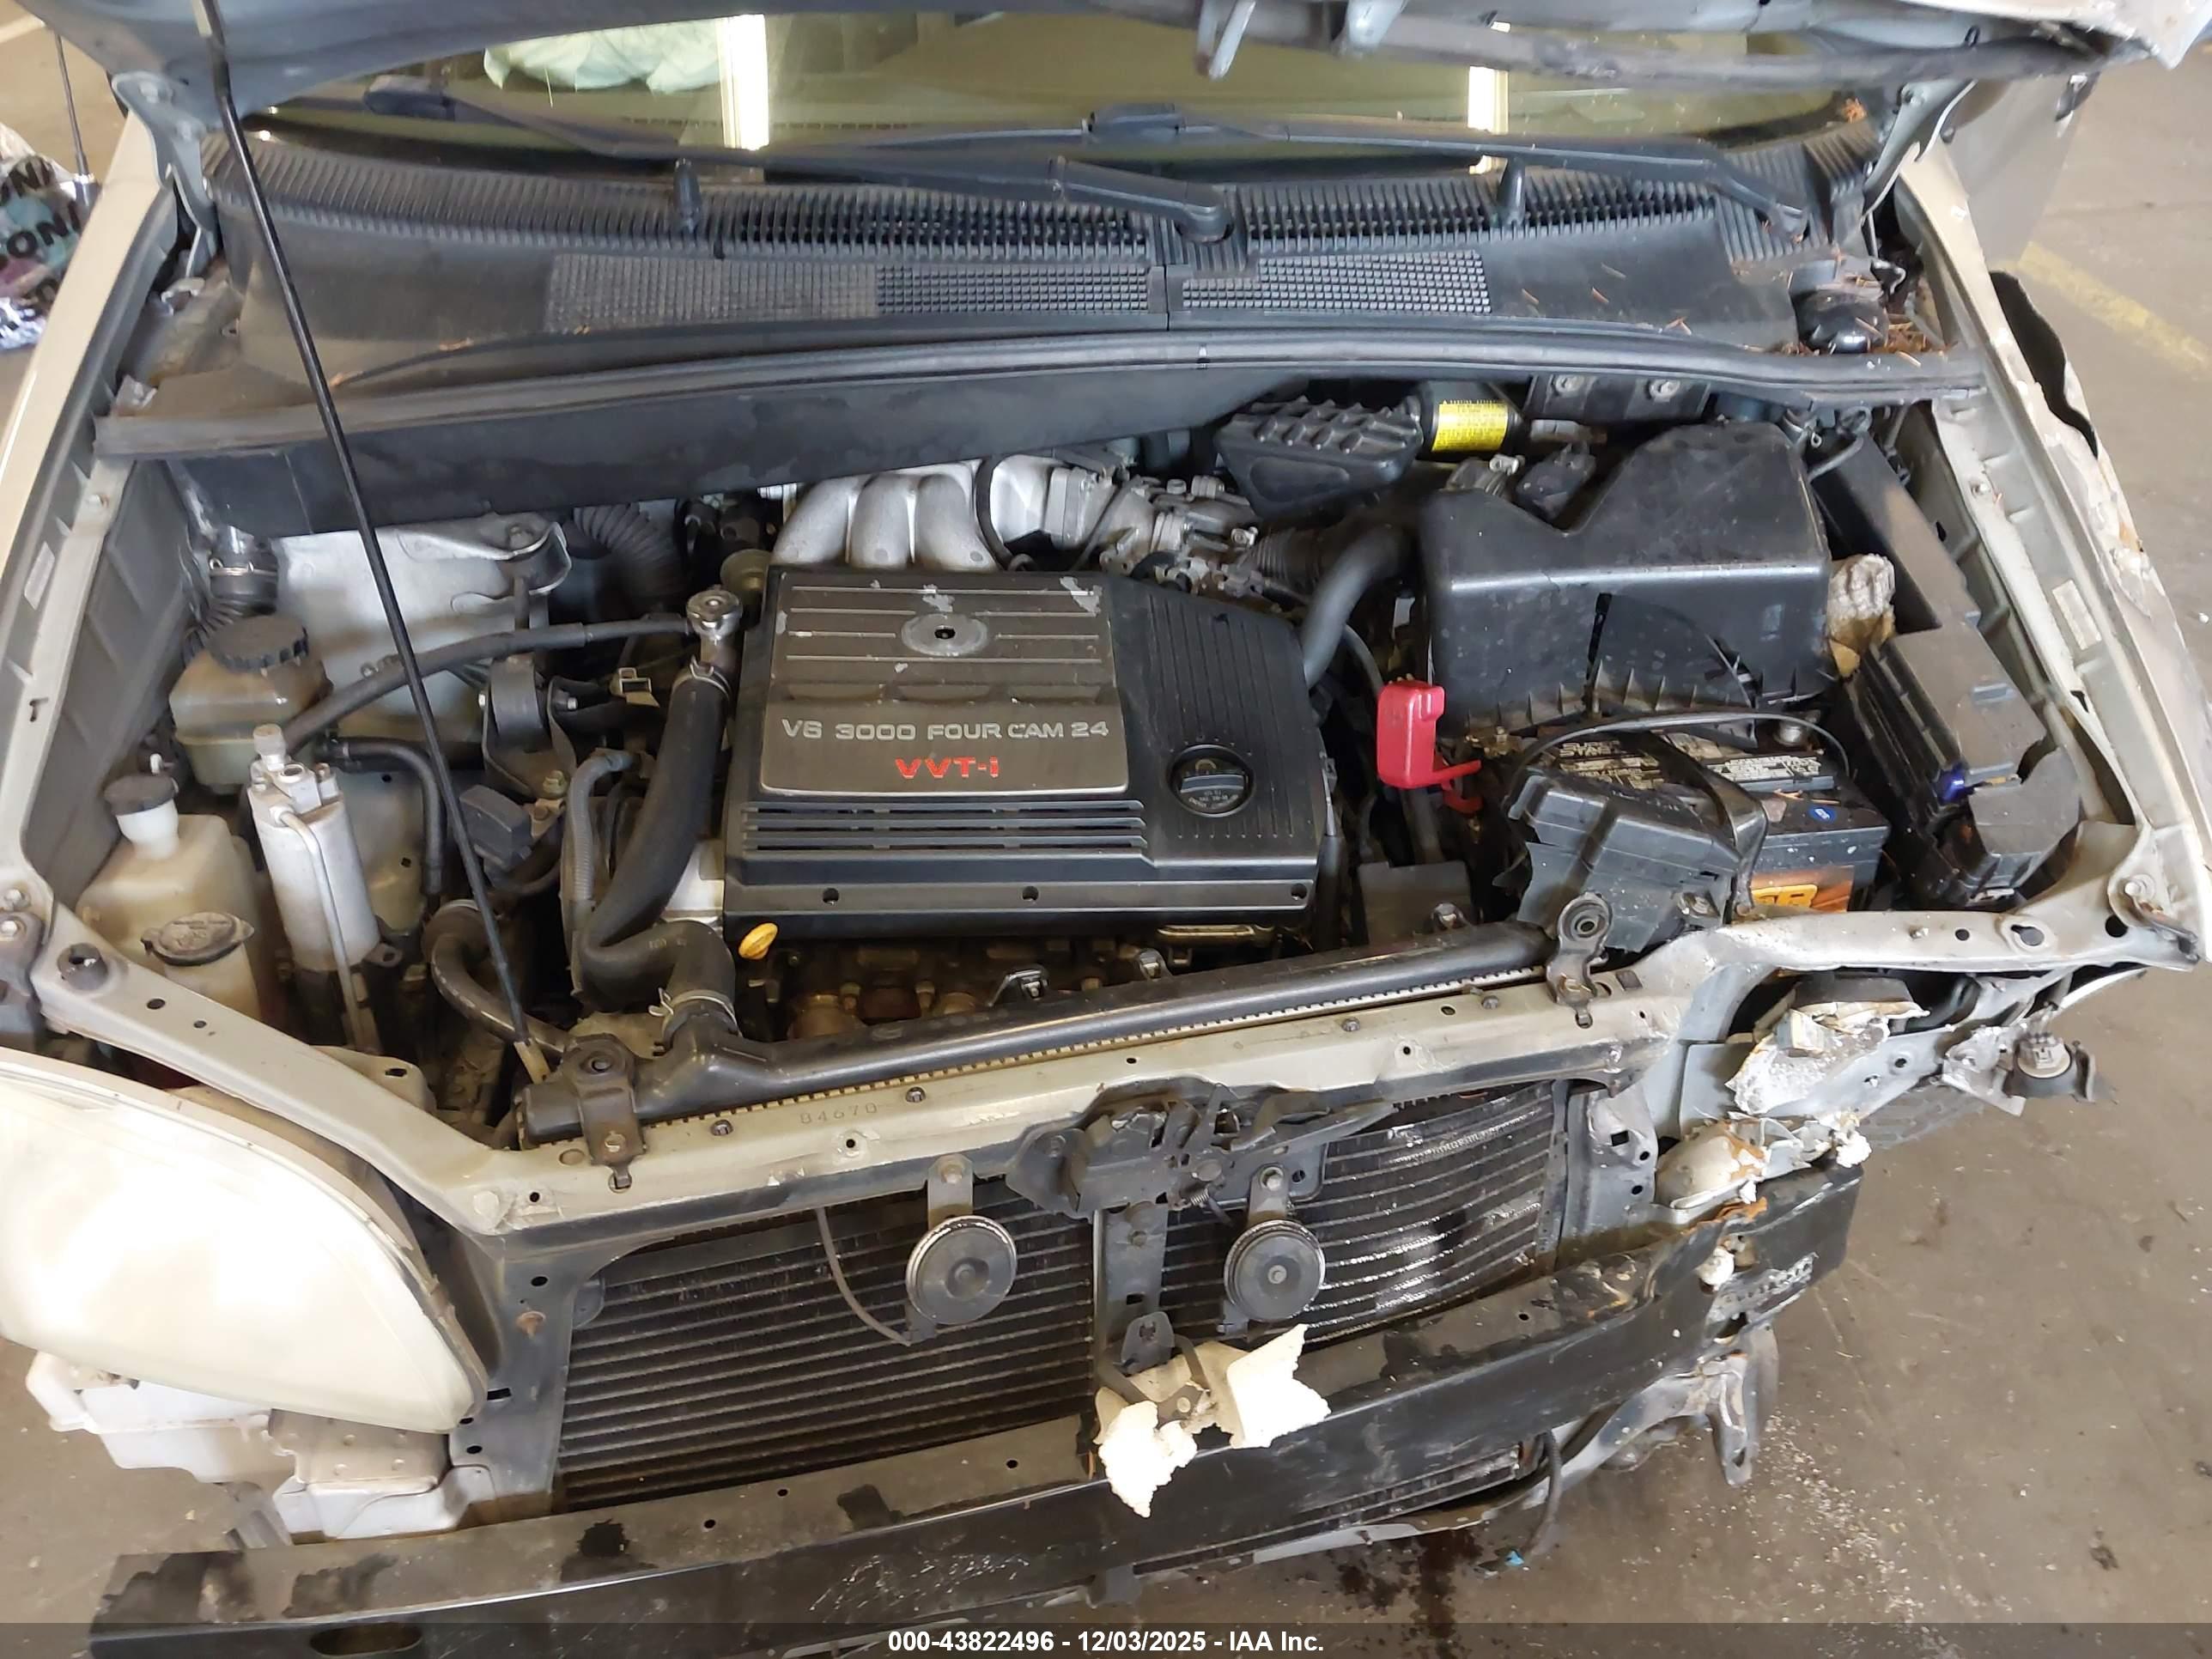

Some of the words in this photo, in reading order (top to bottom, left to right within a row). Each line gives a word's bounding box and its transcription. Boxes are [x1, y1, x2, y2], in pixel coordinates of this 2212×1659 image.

[781, 719, 823, 738] V6
[835, 723, 916, 740] 3000
[927, 722, 1002, 740] FOUR
[1007, 721, 1064, 738] CAM
[1071, 720, 1109, 737] 24
